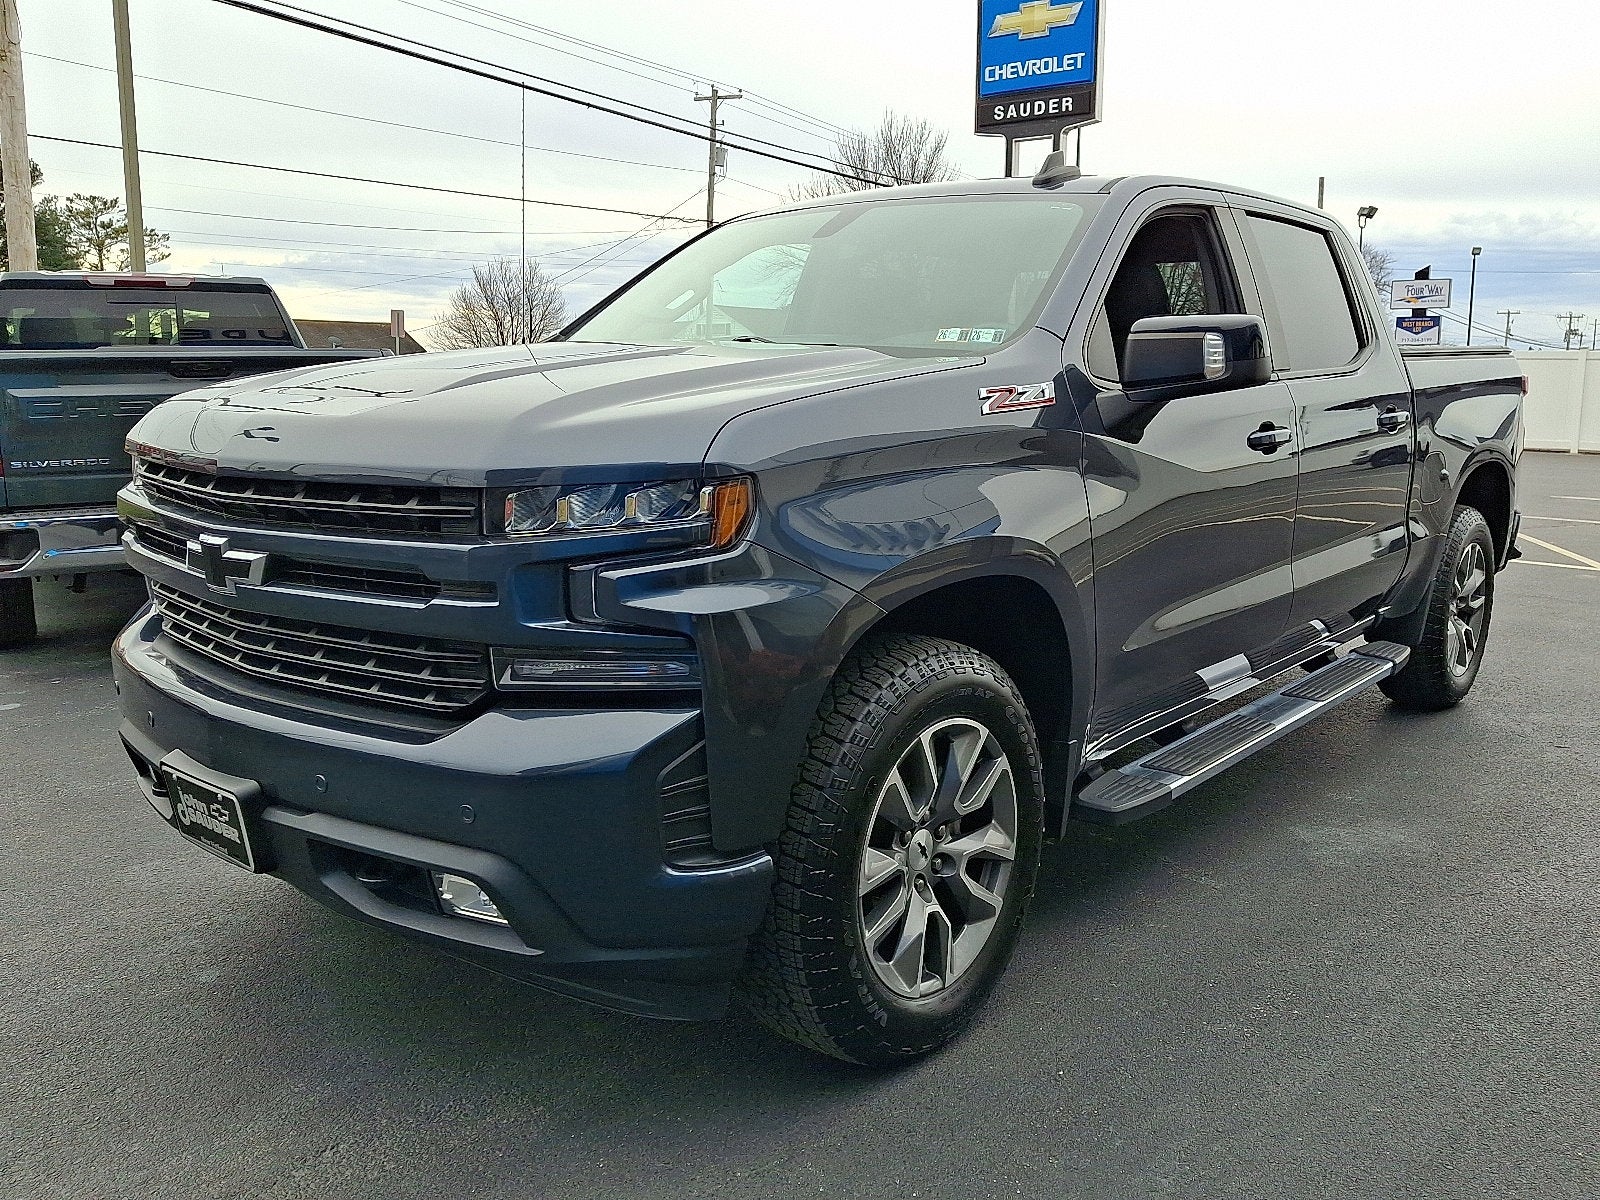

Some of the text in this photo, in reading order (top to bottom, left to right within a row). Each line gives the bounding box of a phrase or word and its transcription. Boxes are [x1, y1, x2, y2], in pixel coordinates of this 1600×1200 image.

[985, 52, 1085, 82] CHEVROLET
[993, 97, 1073, 120] SAUDER
[978, 381, 1056, 416] Z71
[10, 458, 110, 470] SILVERADO
[185, 806, 242, 844] SAUDER
